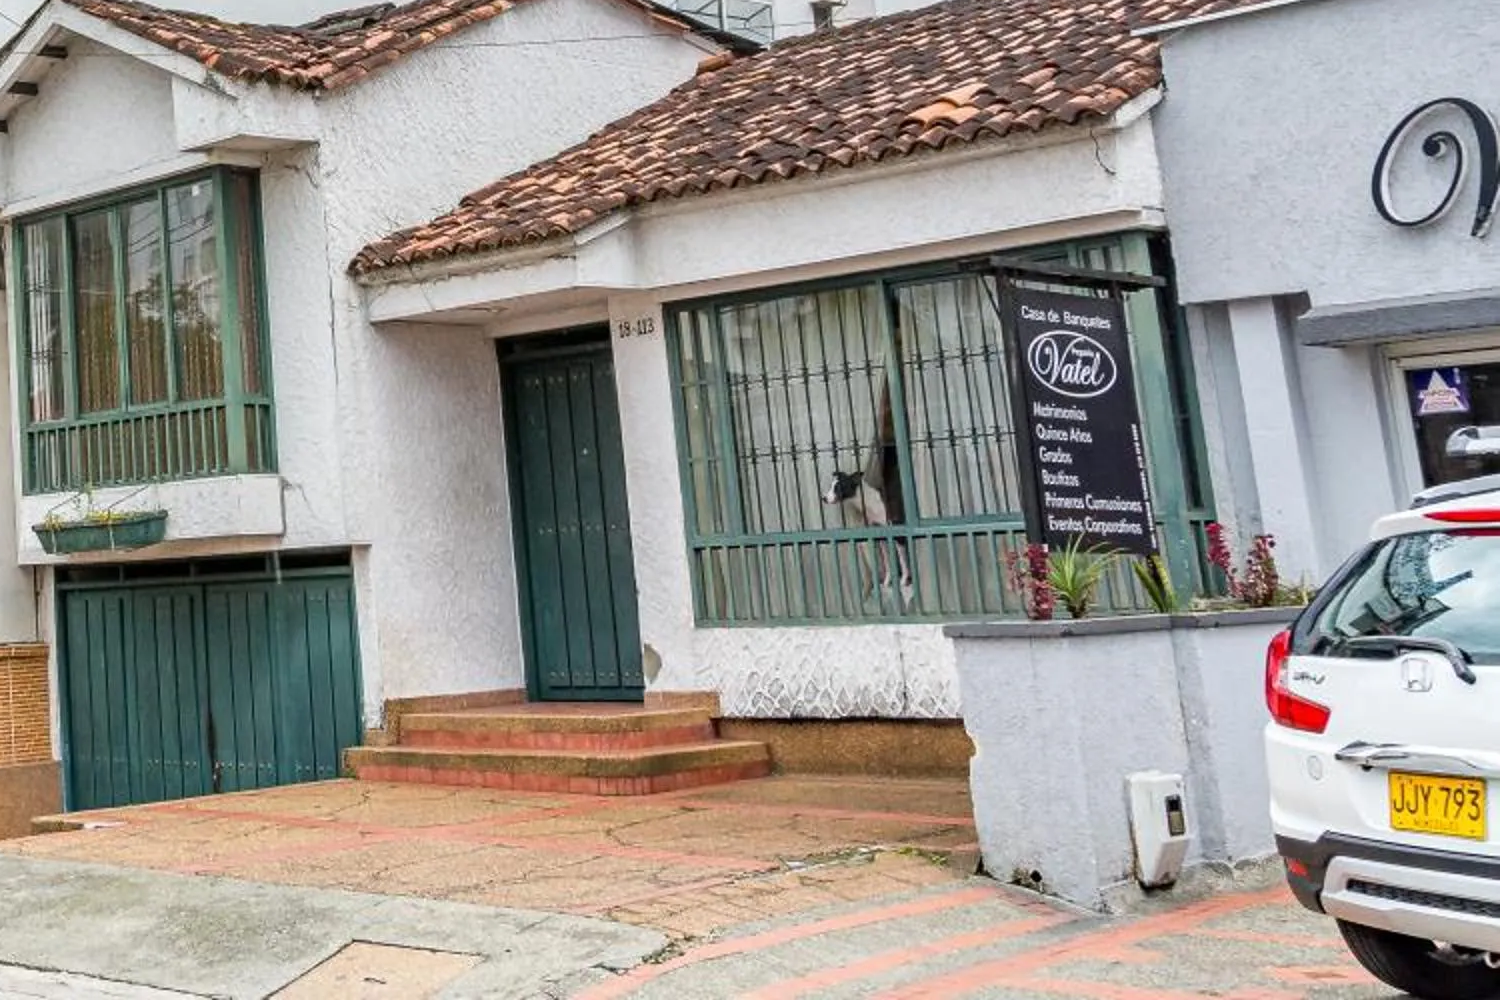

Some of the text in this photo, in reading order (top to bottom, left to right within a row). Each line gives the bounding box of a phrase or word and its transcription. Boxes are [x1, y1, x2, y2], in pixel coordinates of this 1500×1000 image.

[1021, 305, 1111, 330] Casa de Banquetes
[1035, 336, 1105, 386] Vatel
[1035, 423, 1068, 441] Quince
[1039, 446, 1073, 464] Grados
[1048, 515, 1084, 532] Eventos
[1394, 783, 1480, 821] JJY 793
